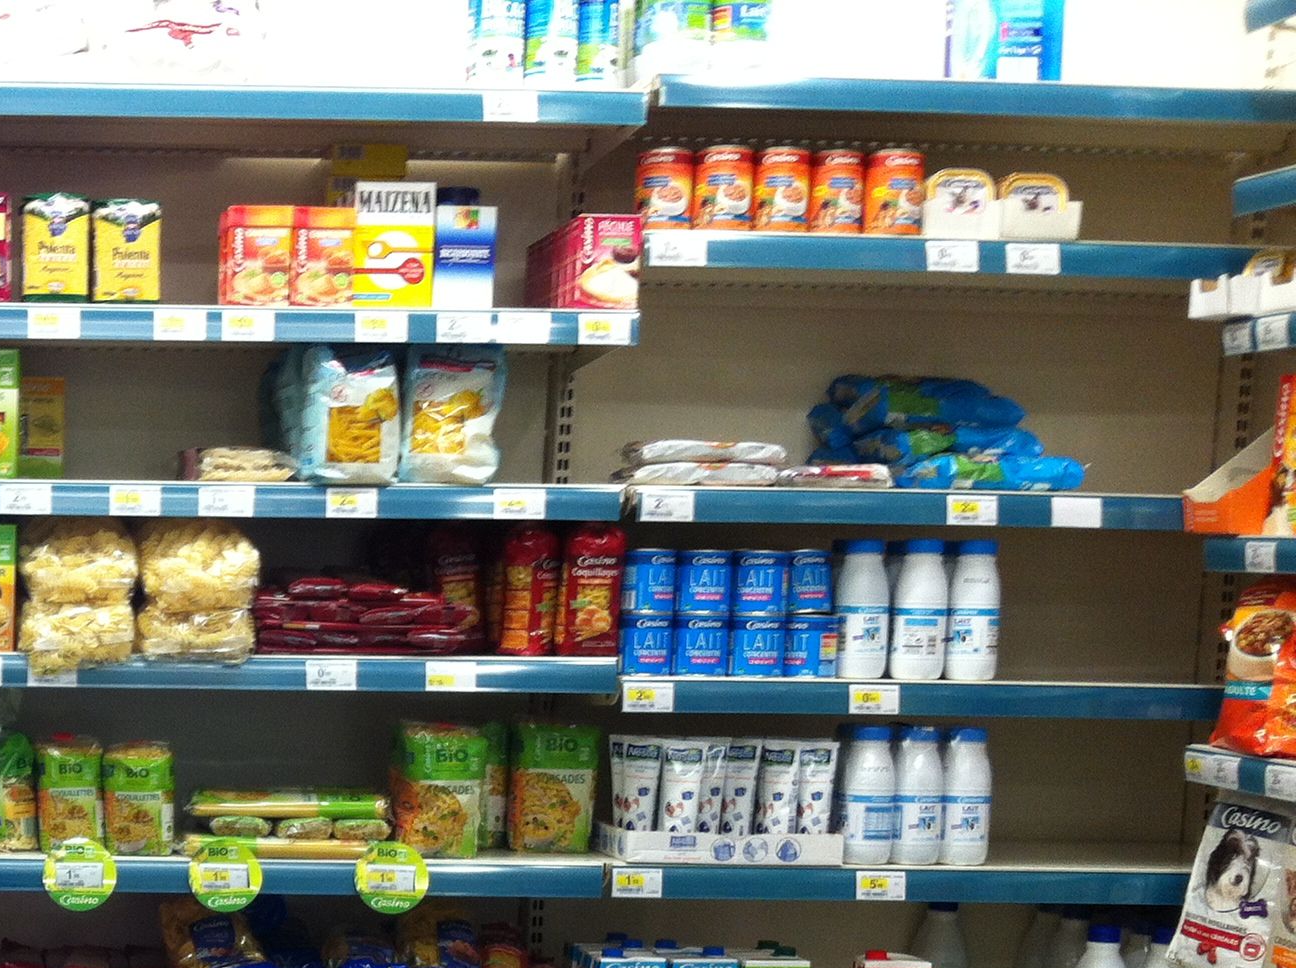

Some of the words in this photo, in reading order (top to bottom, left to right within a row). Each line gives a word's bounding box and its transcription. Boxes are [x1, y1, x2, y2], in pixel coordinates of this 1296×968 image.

[577, 556, 617, 568] Casino
[689, 569, 726, 586] LAIT
[738, 569, 775, 586] LAIT
[686, 632, 722, 650] LAIT
[743, 633, 780, 650] LAIT
[1221, 806, 1282, 834] Casino
[59, 894, 98, 905] Casino
[207, 895, 248, 908] Casino
[370, 897, 411, 909] Casino
